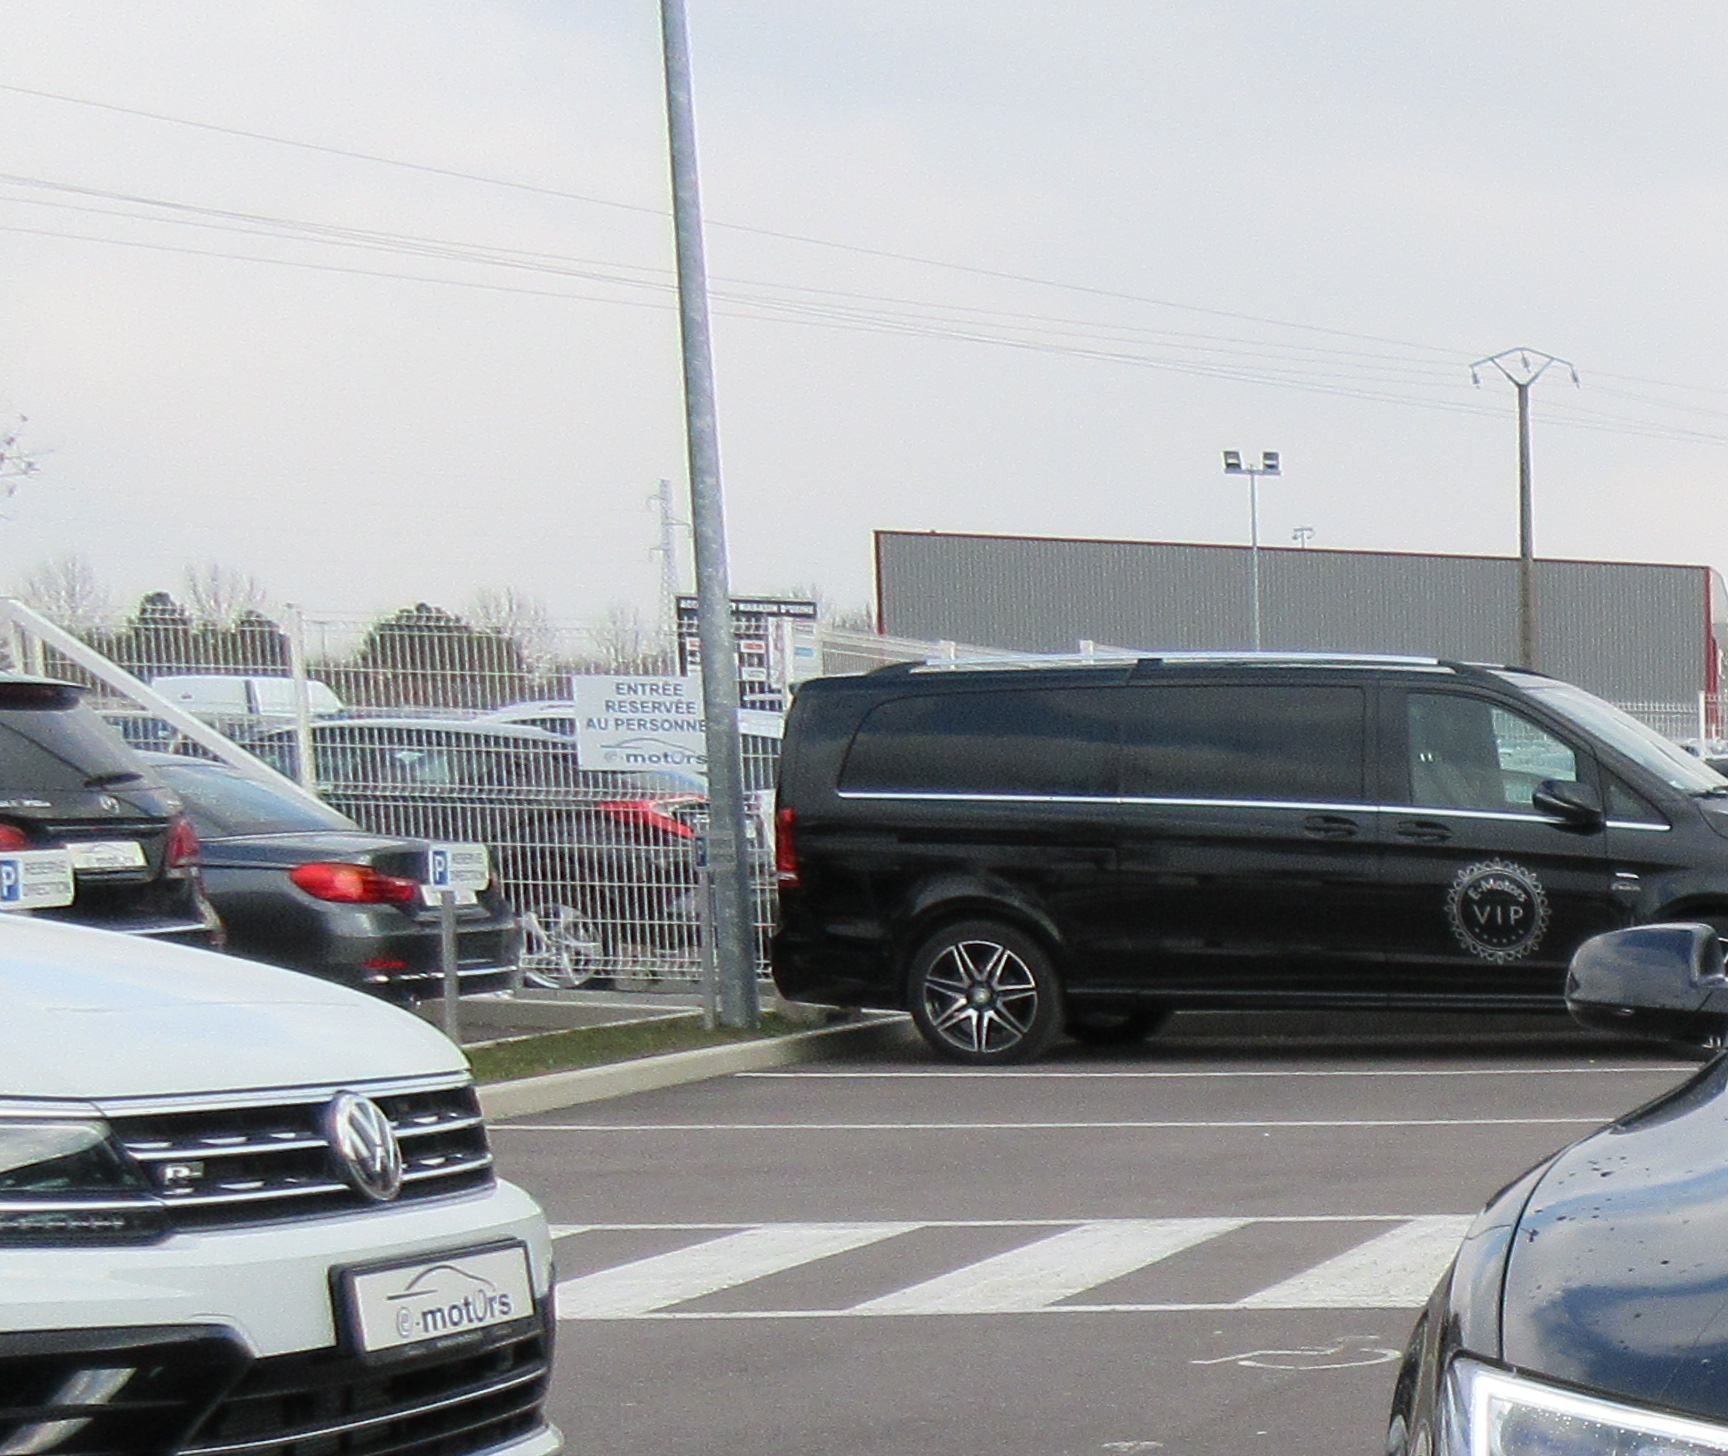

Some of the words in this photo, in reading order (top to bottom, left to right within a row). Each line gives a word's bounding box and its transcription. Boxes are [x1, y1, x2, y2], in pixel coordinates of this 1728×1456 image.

[615, 680, 684, 697] ENTRÉE
[585, 717, 608, 732] AU
[614, 717, 706, 733] PERSONNE
[1473, 905, 1523, 926] VIP
